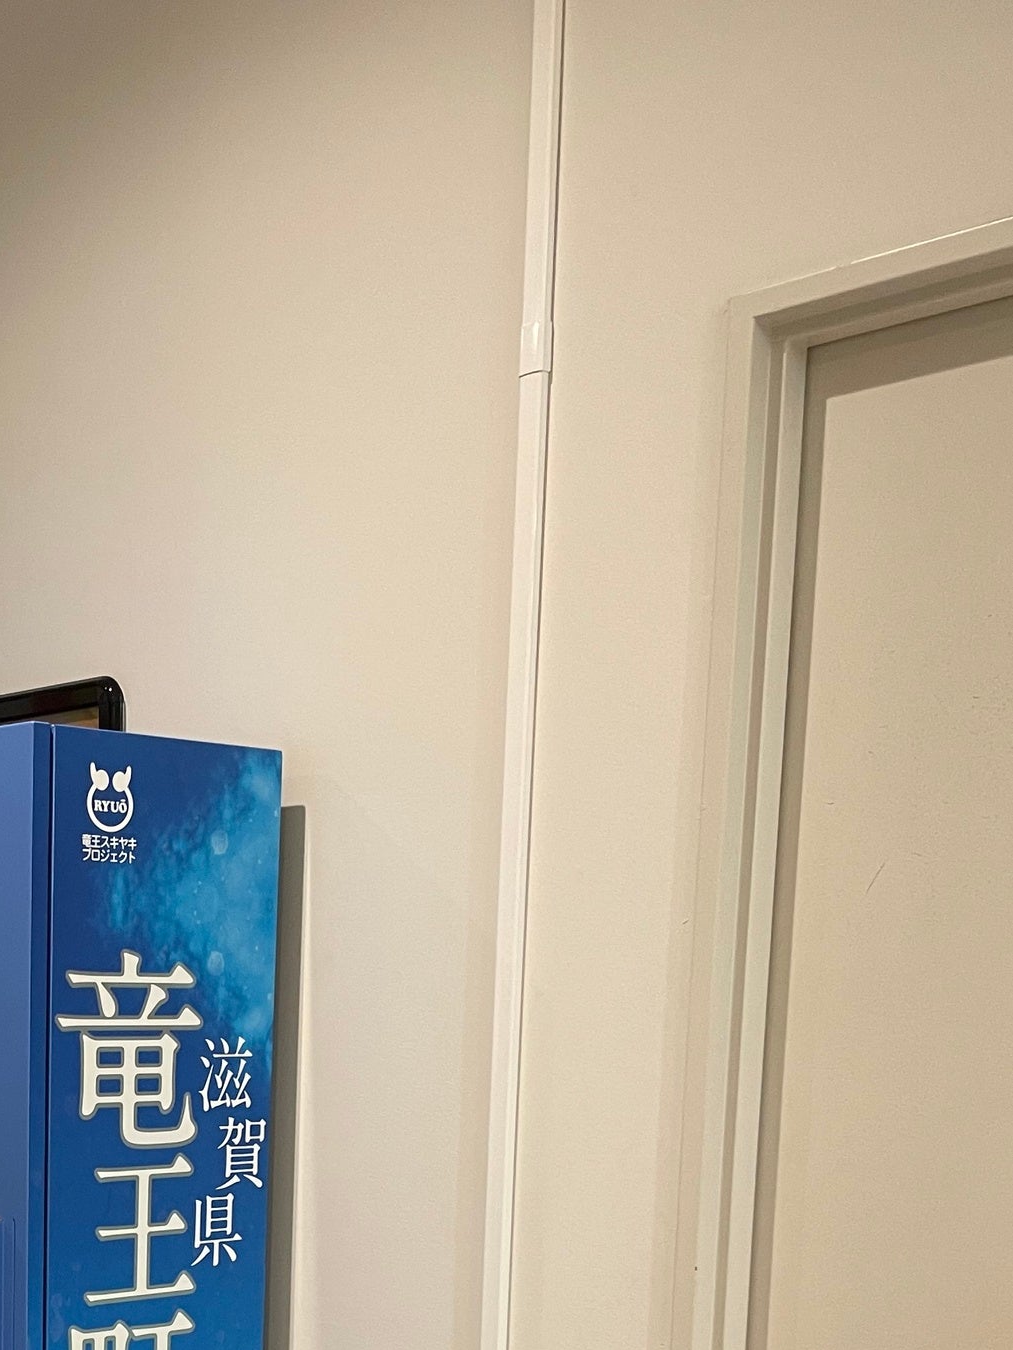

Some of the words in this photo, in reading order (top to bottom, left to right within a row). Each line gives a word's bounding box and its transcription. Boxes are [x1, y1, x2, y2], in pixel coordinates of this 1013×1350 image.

[81, 833, 137, 851] 竜王スキヤキ
[82, 847, 136, 864] プロジェクト
[191, 1036, 267, 1267] 滋賀県
